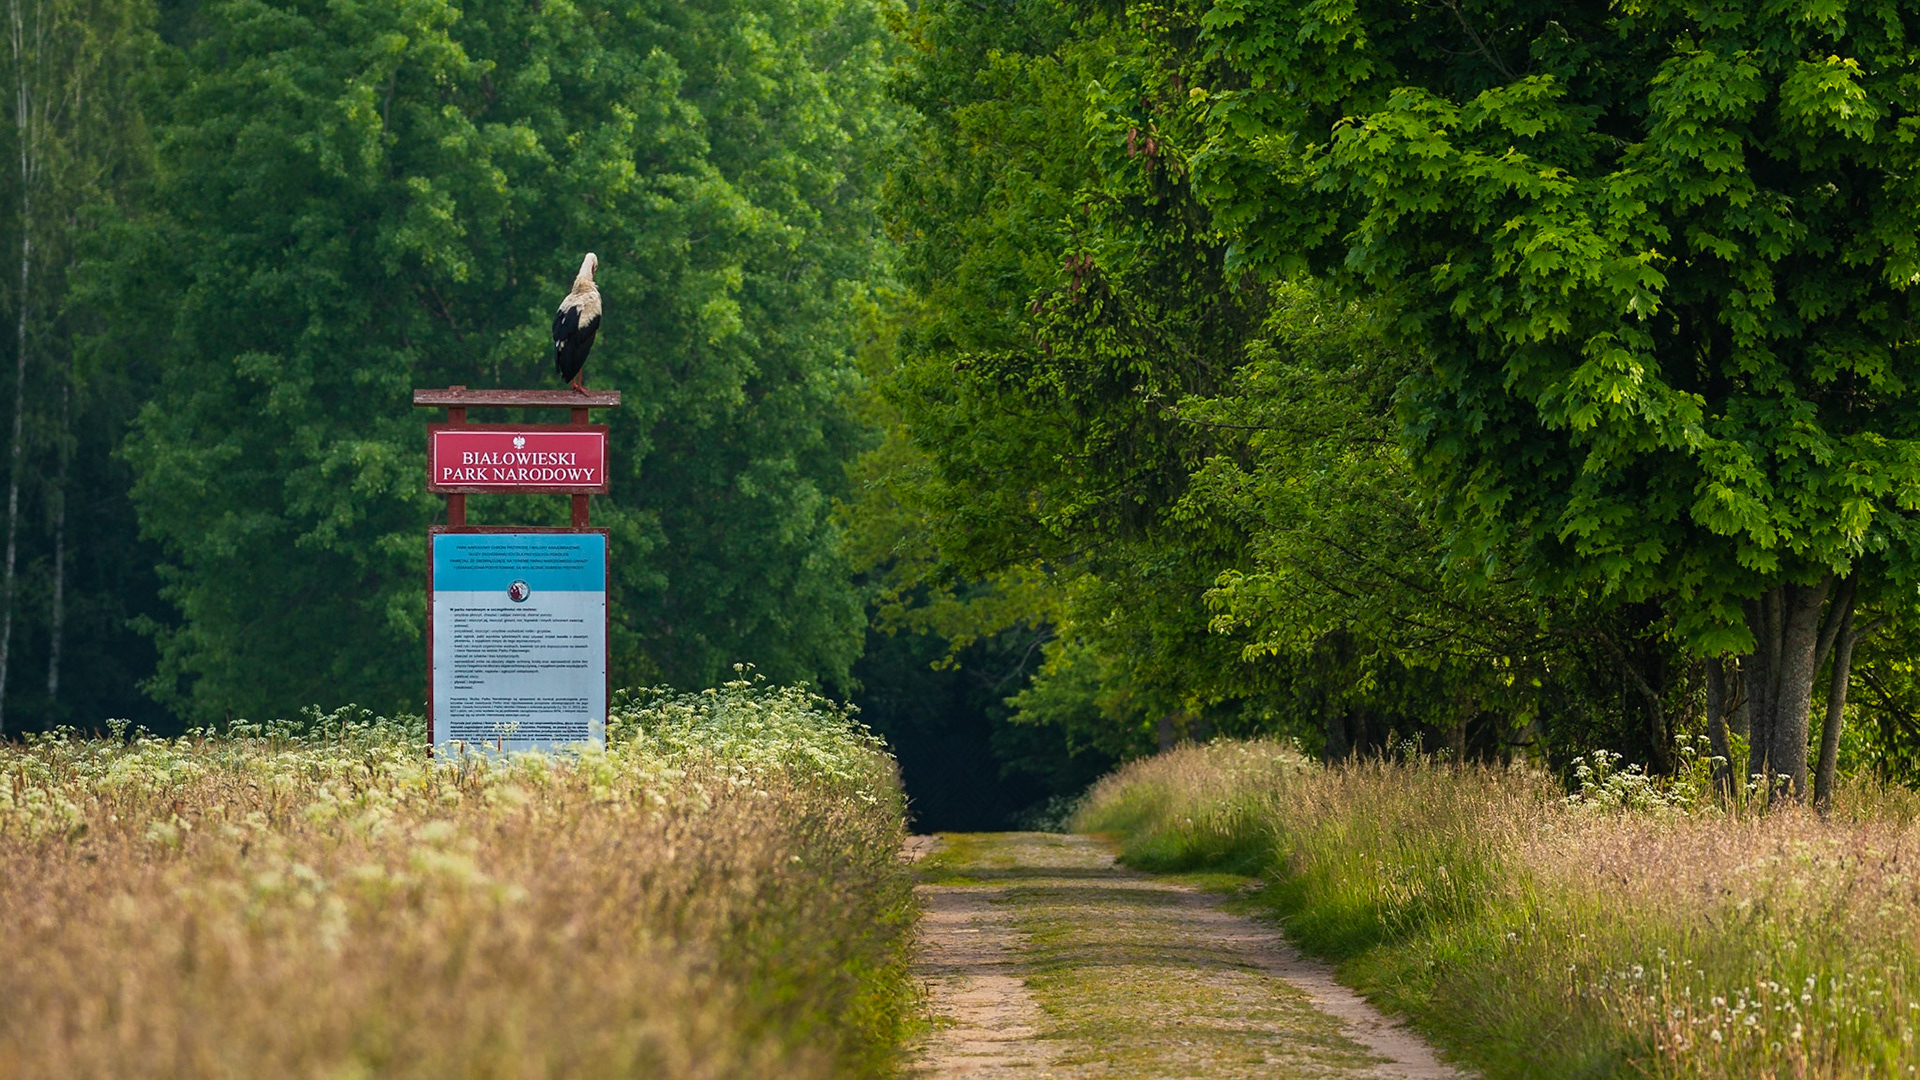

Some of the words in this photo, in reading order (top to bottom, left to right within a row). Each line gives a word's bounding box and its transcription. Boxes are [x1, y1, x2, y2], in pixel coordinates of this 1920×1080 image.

[462, 452, 576, 465] BIAŁOWIESKI
[443, 468, 488, 480] PARK
[493, 468, 595, 481] NARODOWY
